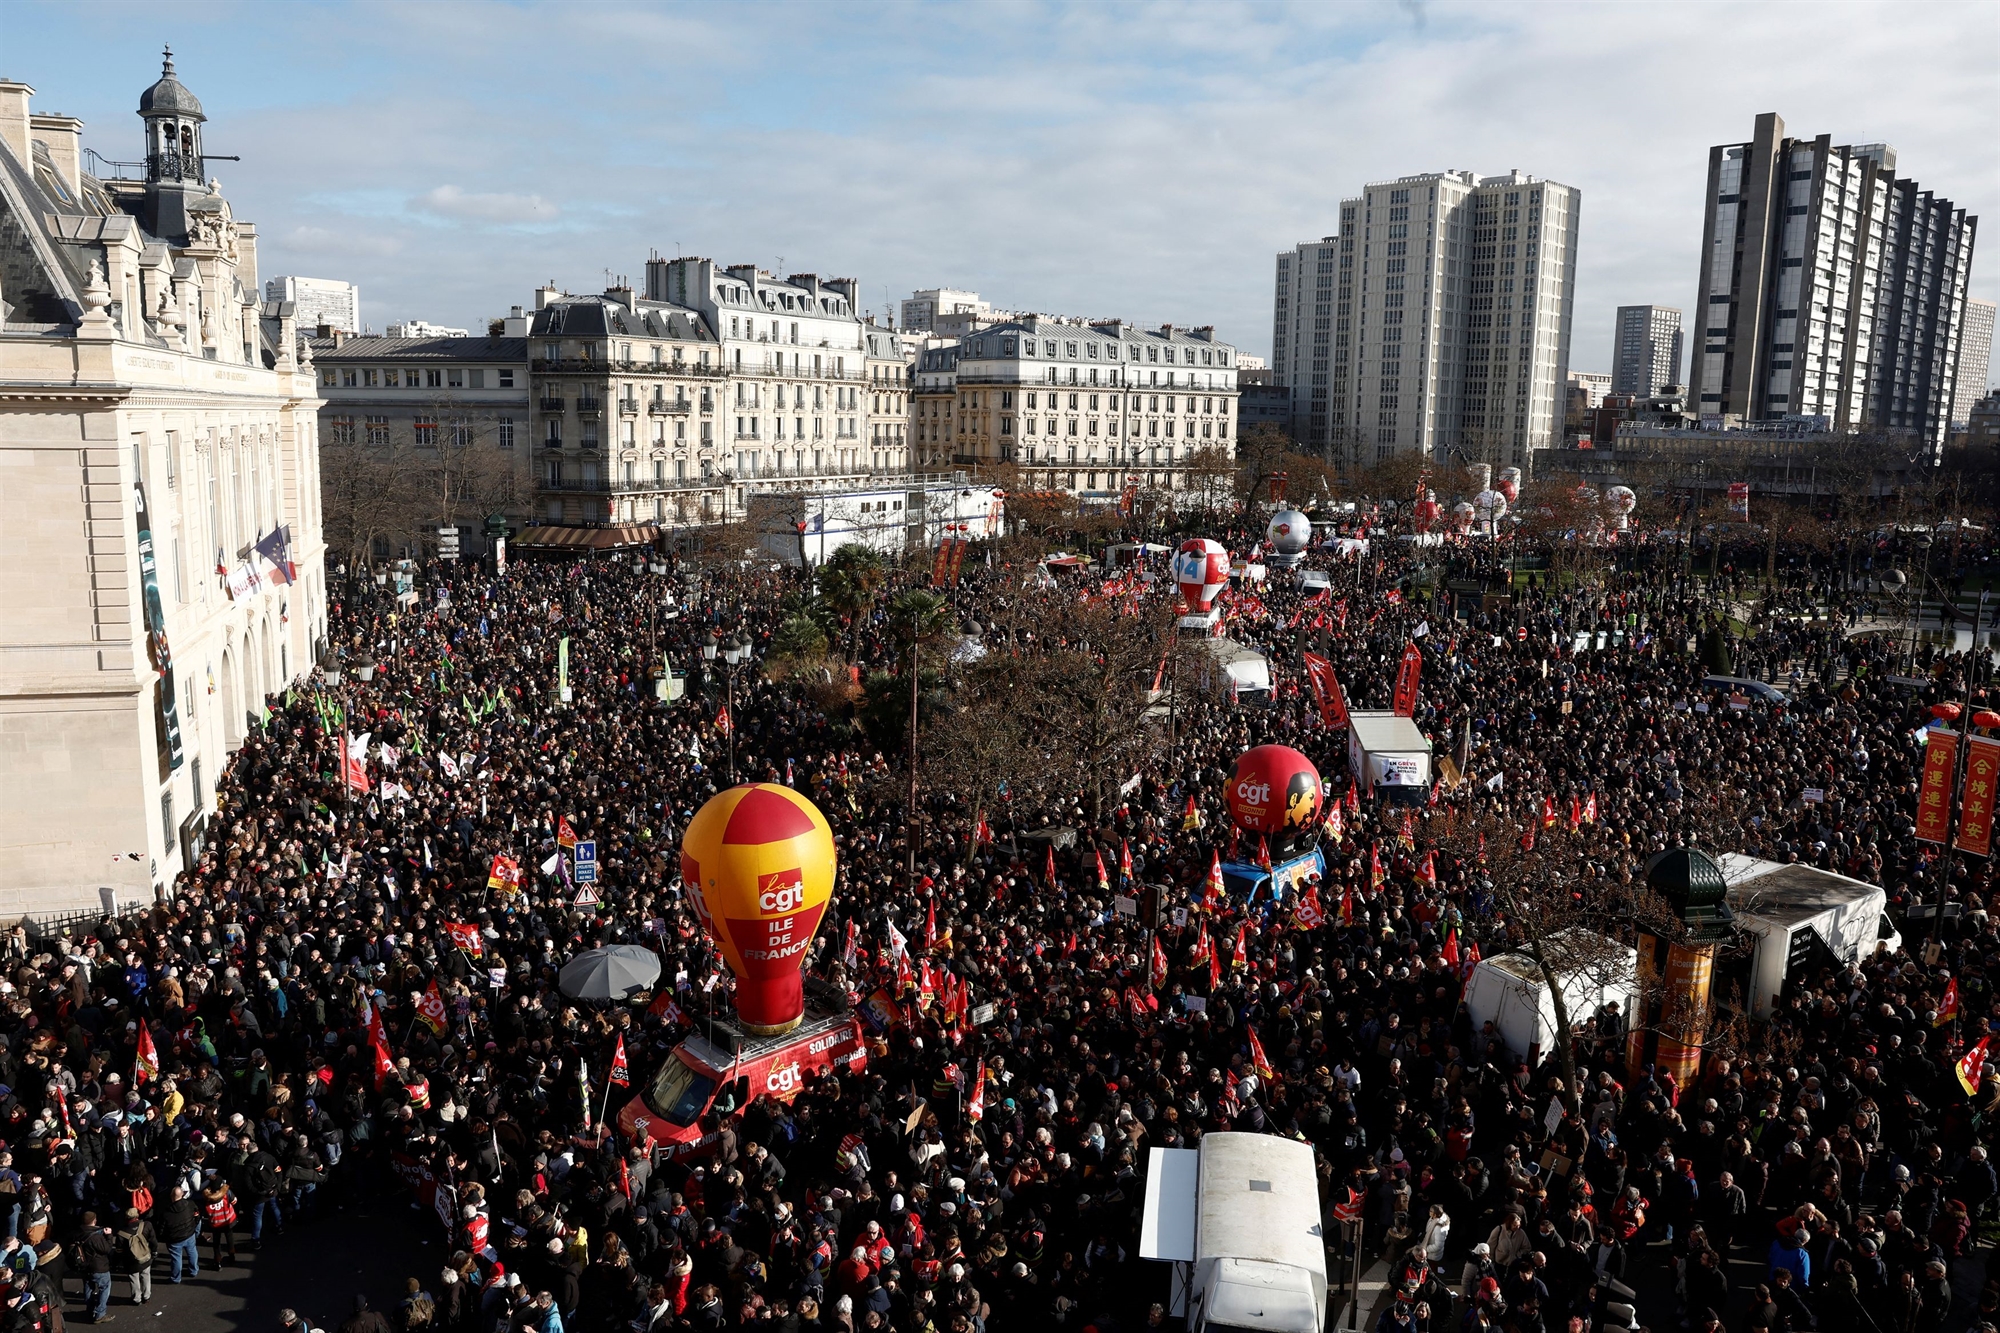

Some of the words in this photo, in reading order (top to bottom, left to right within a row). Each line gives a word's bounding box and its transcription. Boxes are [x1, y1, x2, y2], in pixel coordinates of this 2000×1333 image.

[1237, 783, 1270, 805] cgt
[1924, 748, 1947, 827] 好運連年
[1239, 805, 1265, 815] ESSONNE
[1965, 759, 1992, 839] 合境平安
[1244, 815, 1259, 826] 91
[496, 864, 519, 882] cgt
[762, 874, 795, 894] la
[759, 881, 802, 912] cgt
[769, 917, 793, 933] ILE
[744, 936, 810, 960] FRANCE
[769, 933, 791, 947] DE
[664, 1001, 681, 1023] gt
[868, 999, 892, 1026] cgt
[809, 1028, 854, 1054] SOLIDAIRE
[767, 1057, 787, 1077] la
[833, 1046, 867, 1068] ENGAGÉE
[767, 1063, 801, 1091] cgt
[634, 1117, 650, 1129] cgt
[210, 1199, 224, 1211] cgt
